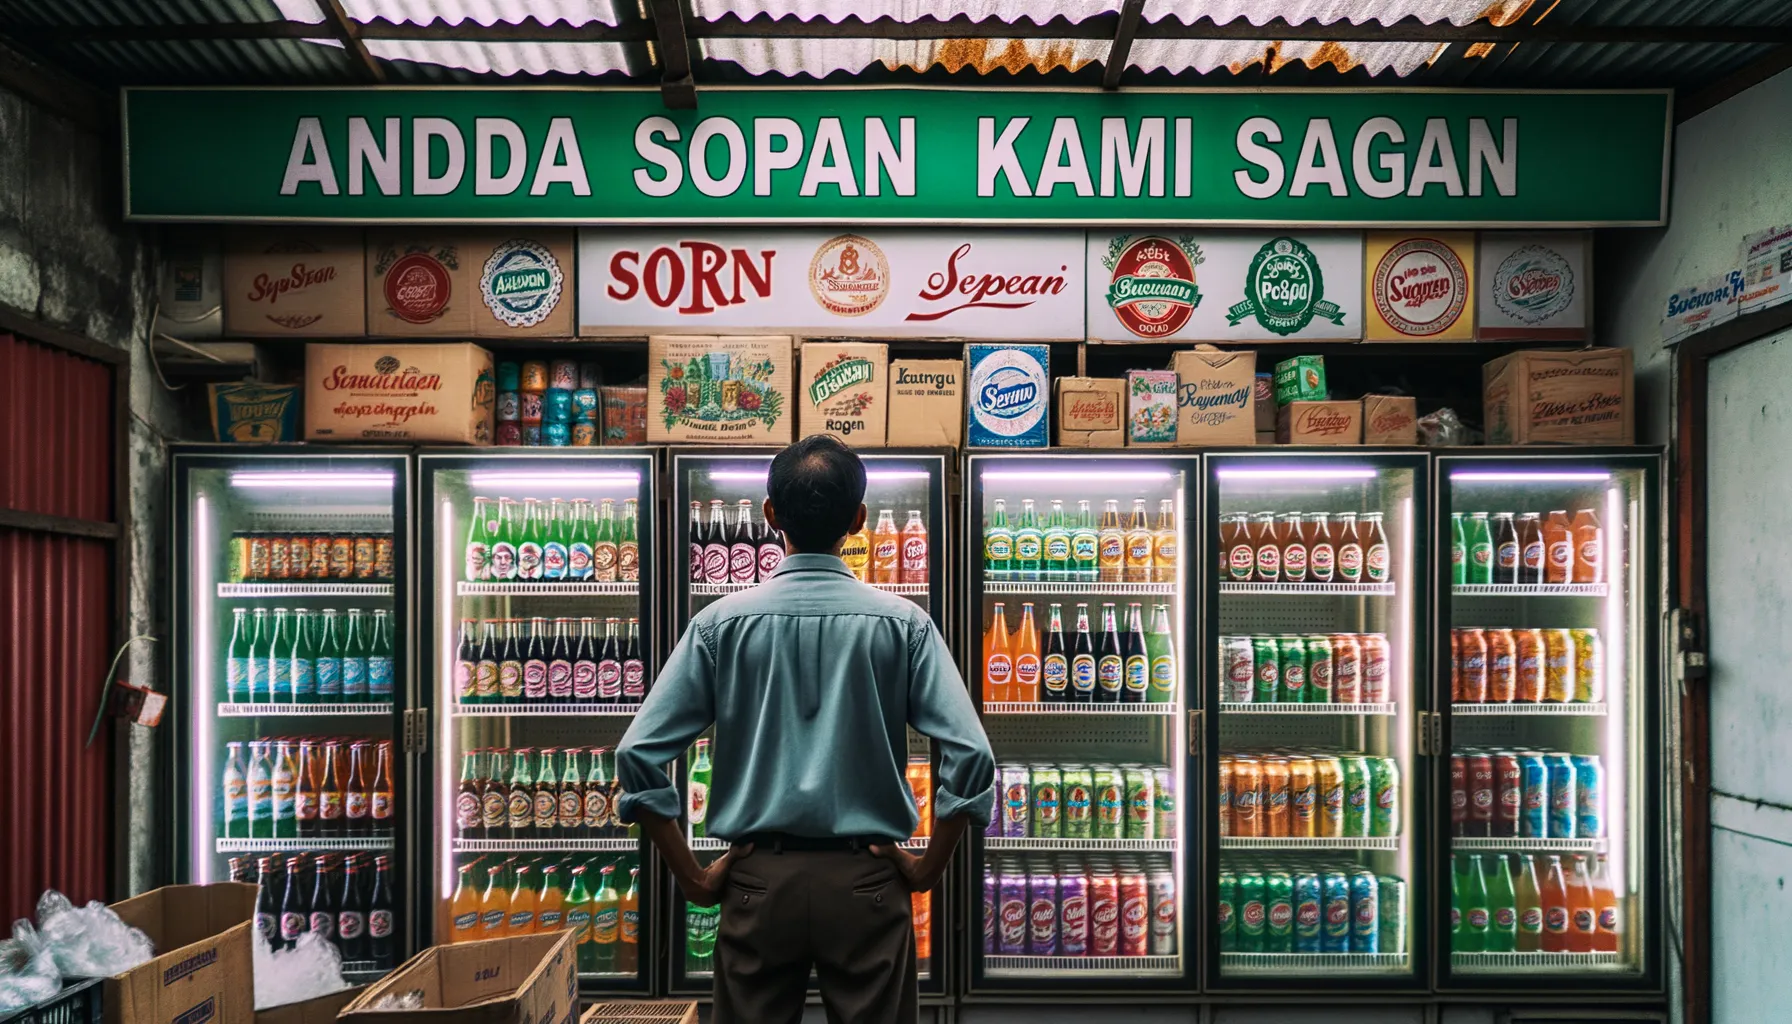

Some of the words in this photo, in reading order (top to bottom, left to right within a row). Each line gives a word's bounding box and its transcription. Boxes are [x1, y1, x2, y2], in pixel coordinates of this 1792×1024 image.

[281, 117, 590, 196] ANDDA
[633, 116, 917, 197] SOPAN
[977, 117, 1193, 197] KAMI
[1234, 117, 1518, 199] SAGAN
[607, 241, 777, 315] SORN
